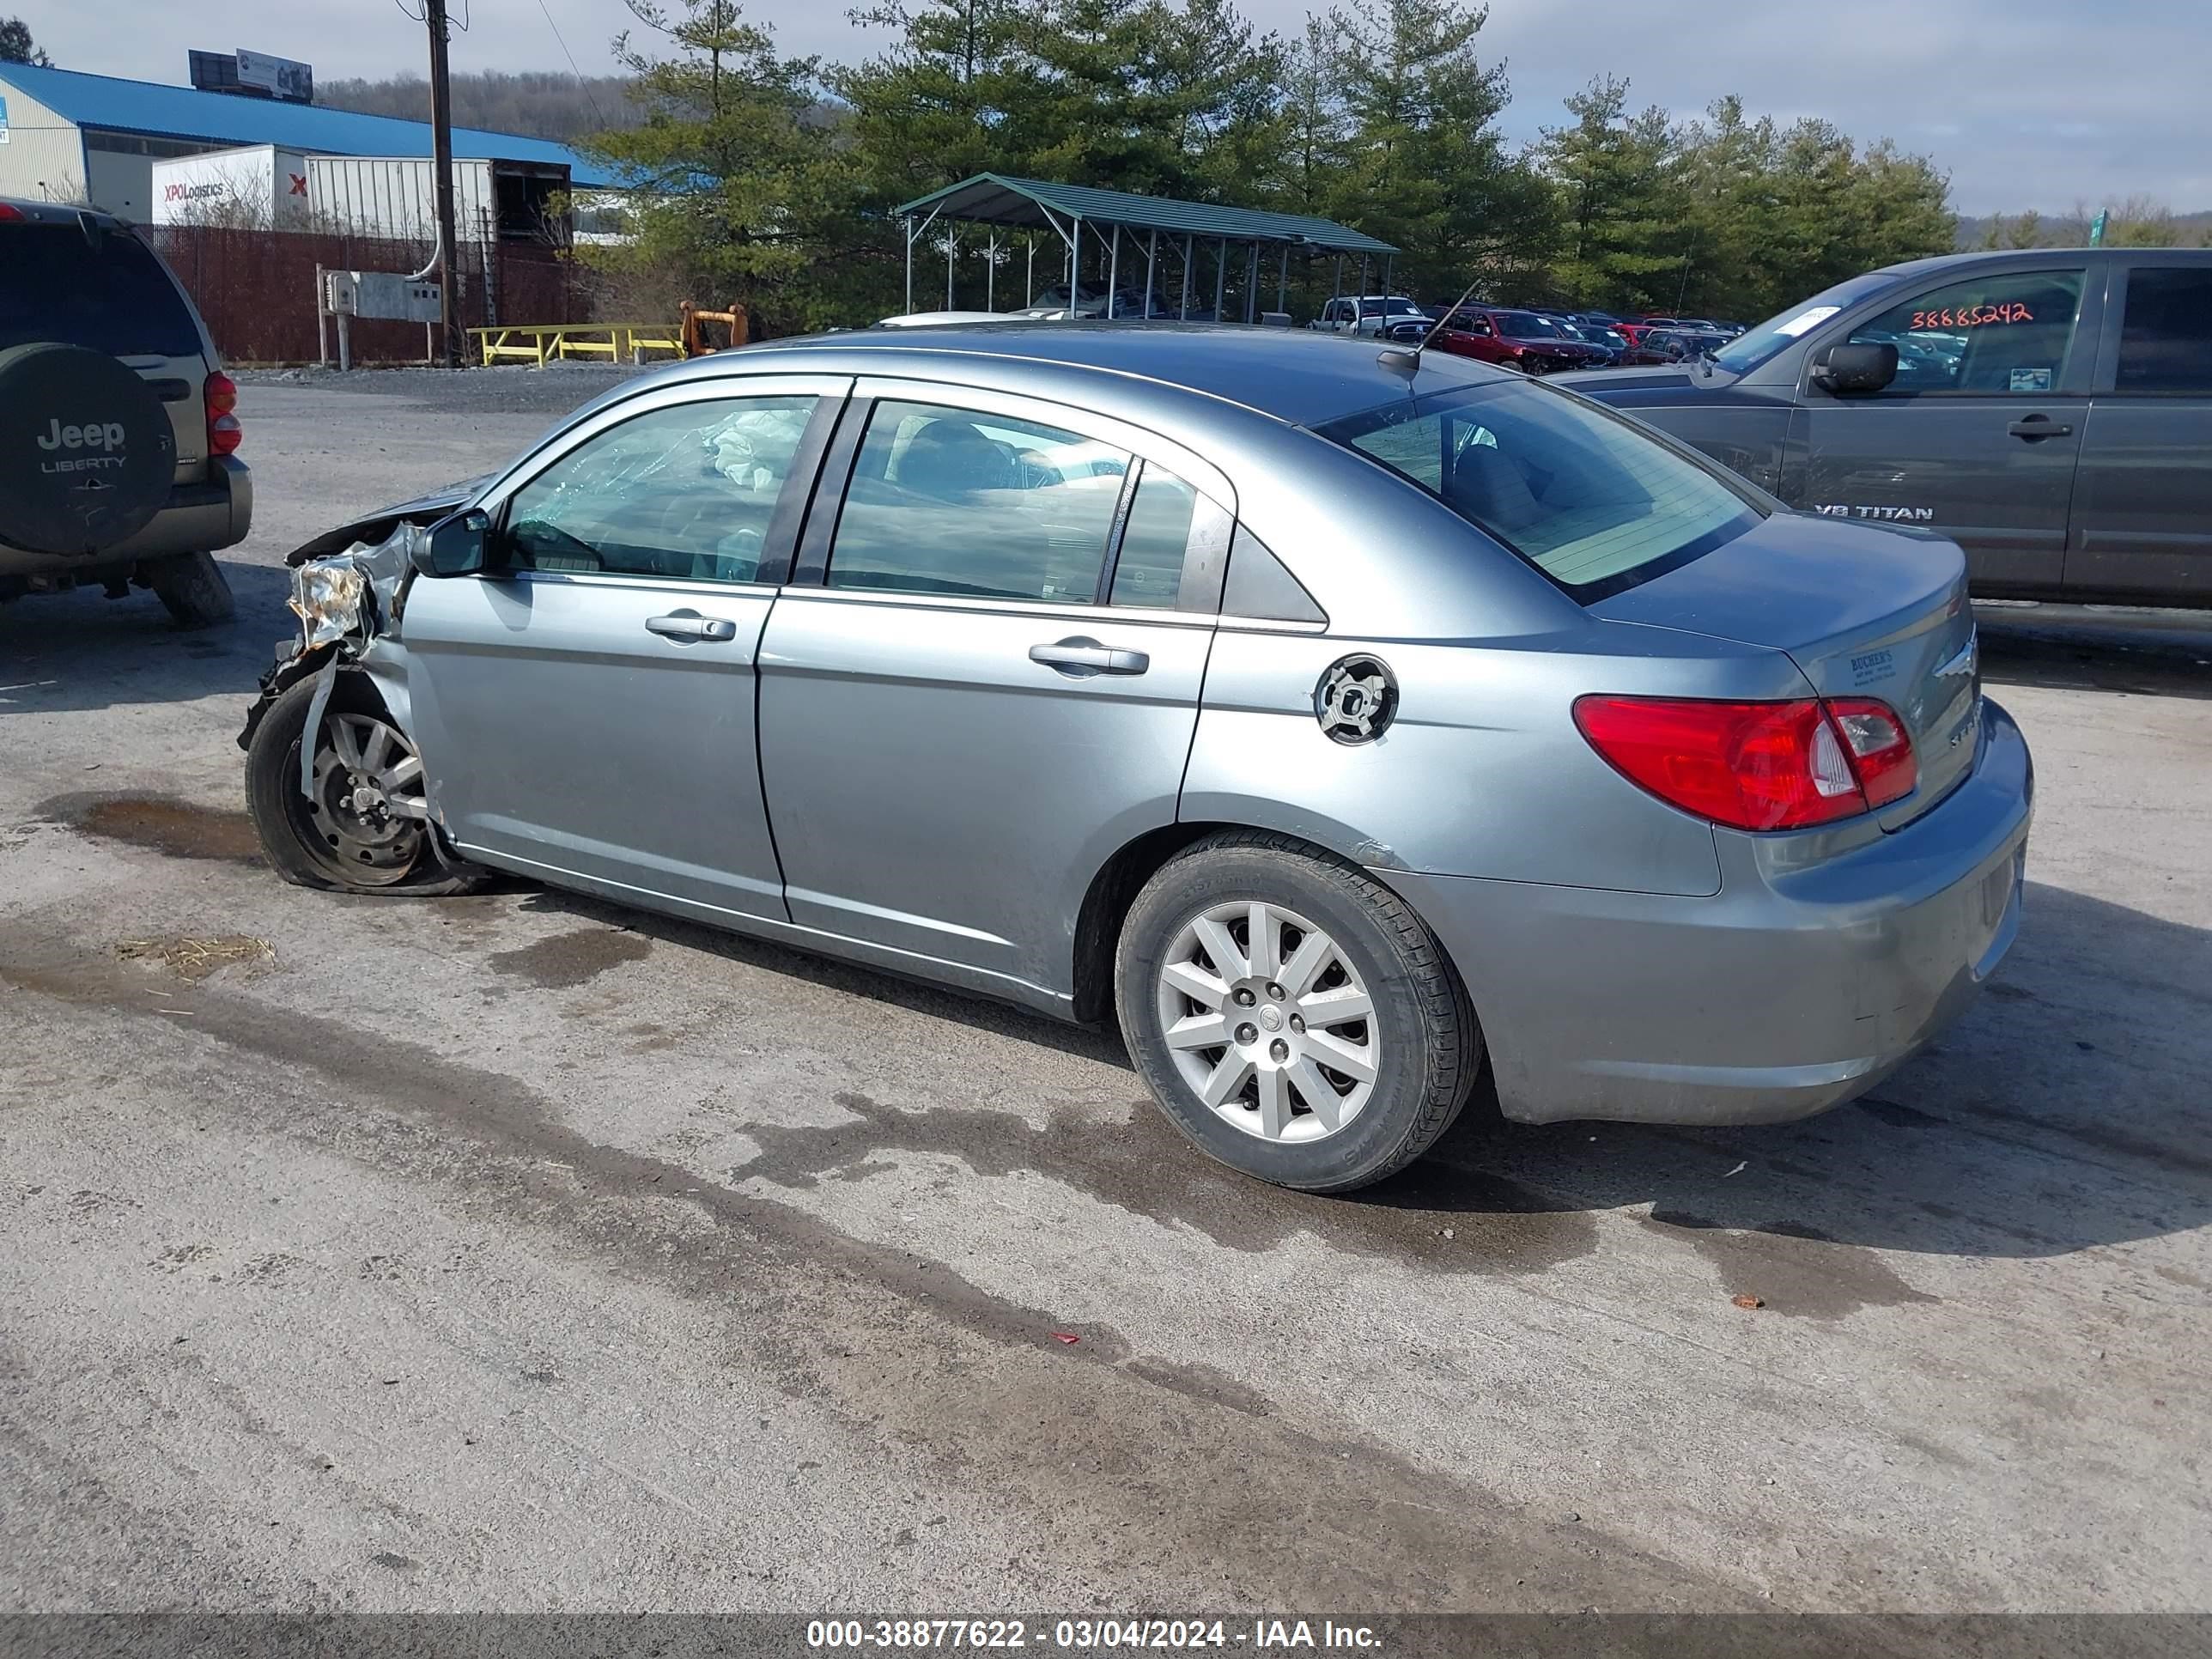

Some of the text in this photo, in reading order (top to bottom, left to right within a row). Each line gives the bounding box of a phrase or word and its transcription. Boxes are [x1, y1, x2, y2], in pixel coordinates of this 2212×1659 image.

[1910, 303, 2034, 330] 38885242
[37, 418, 125, 452] Jeep
[40, 456, 127, 474] LIBERTY
[1814, 504, 1934, 520] V8 TITAN
